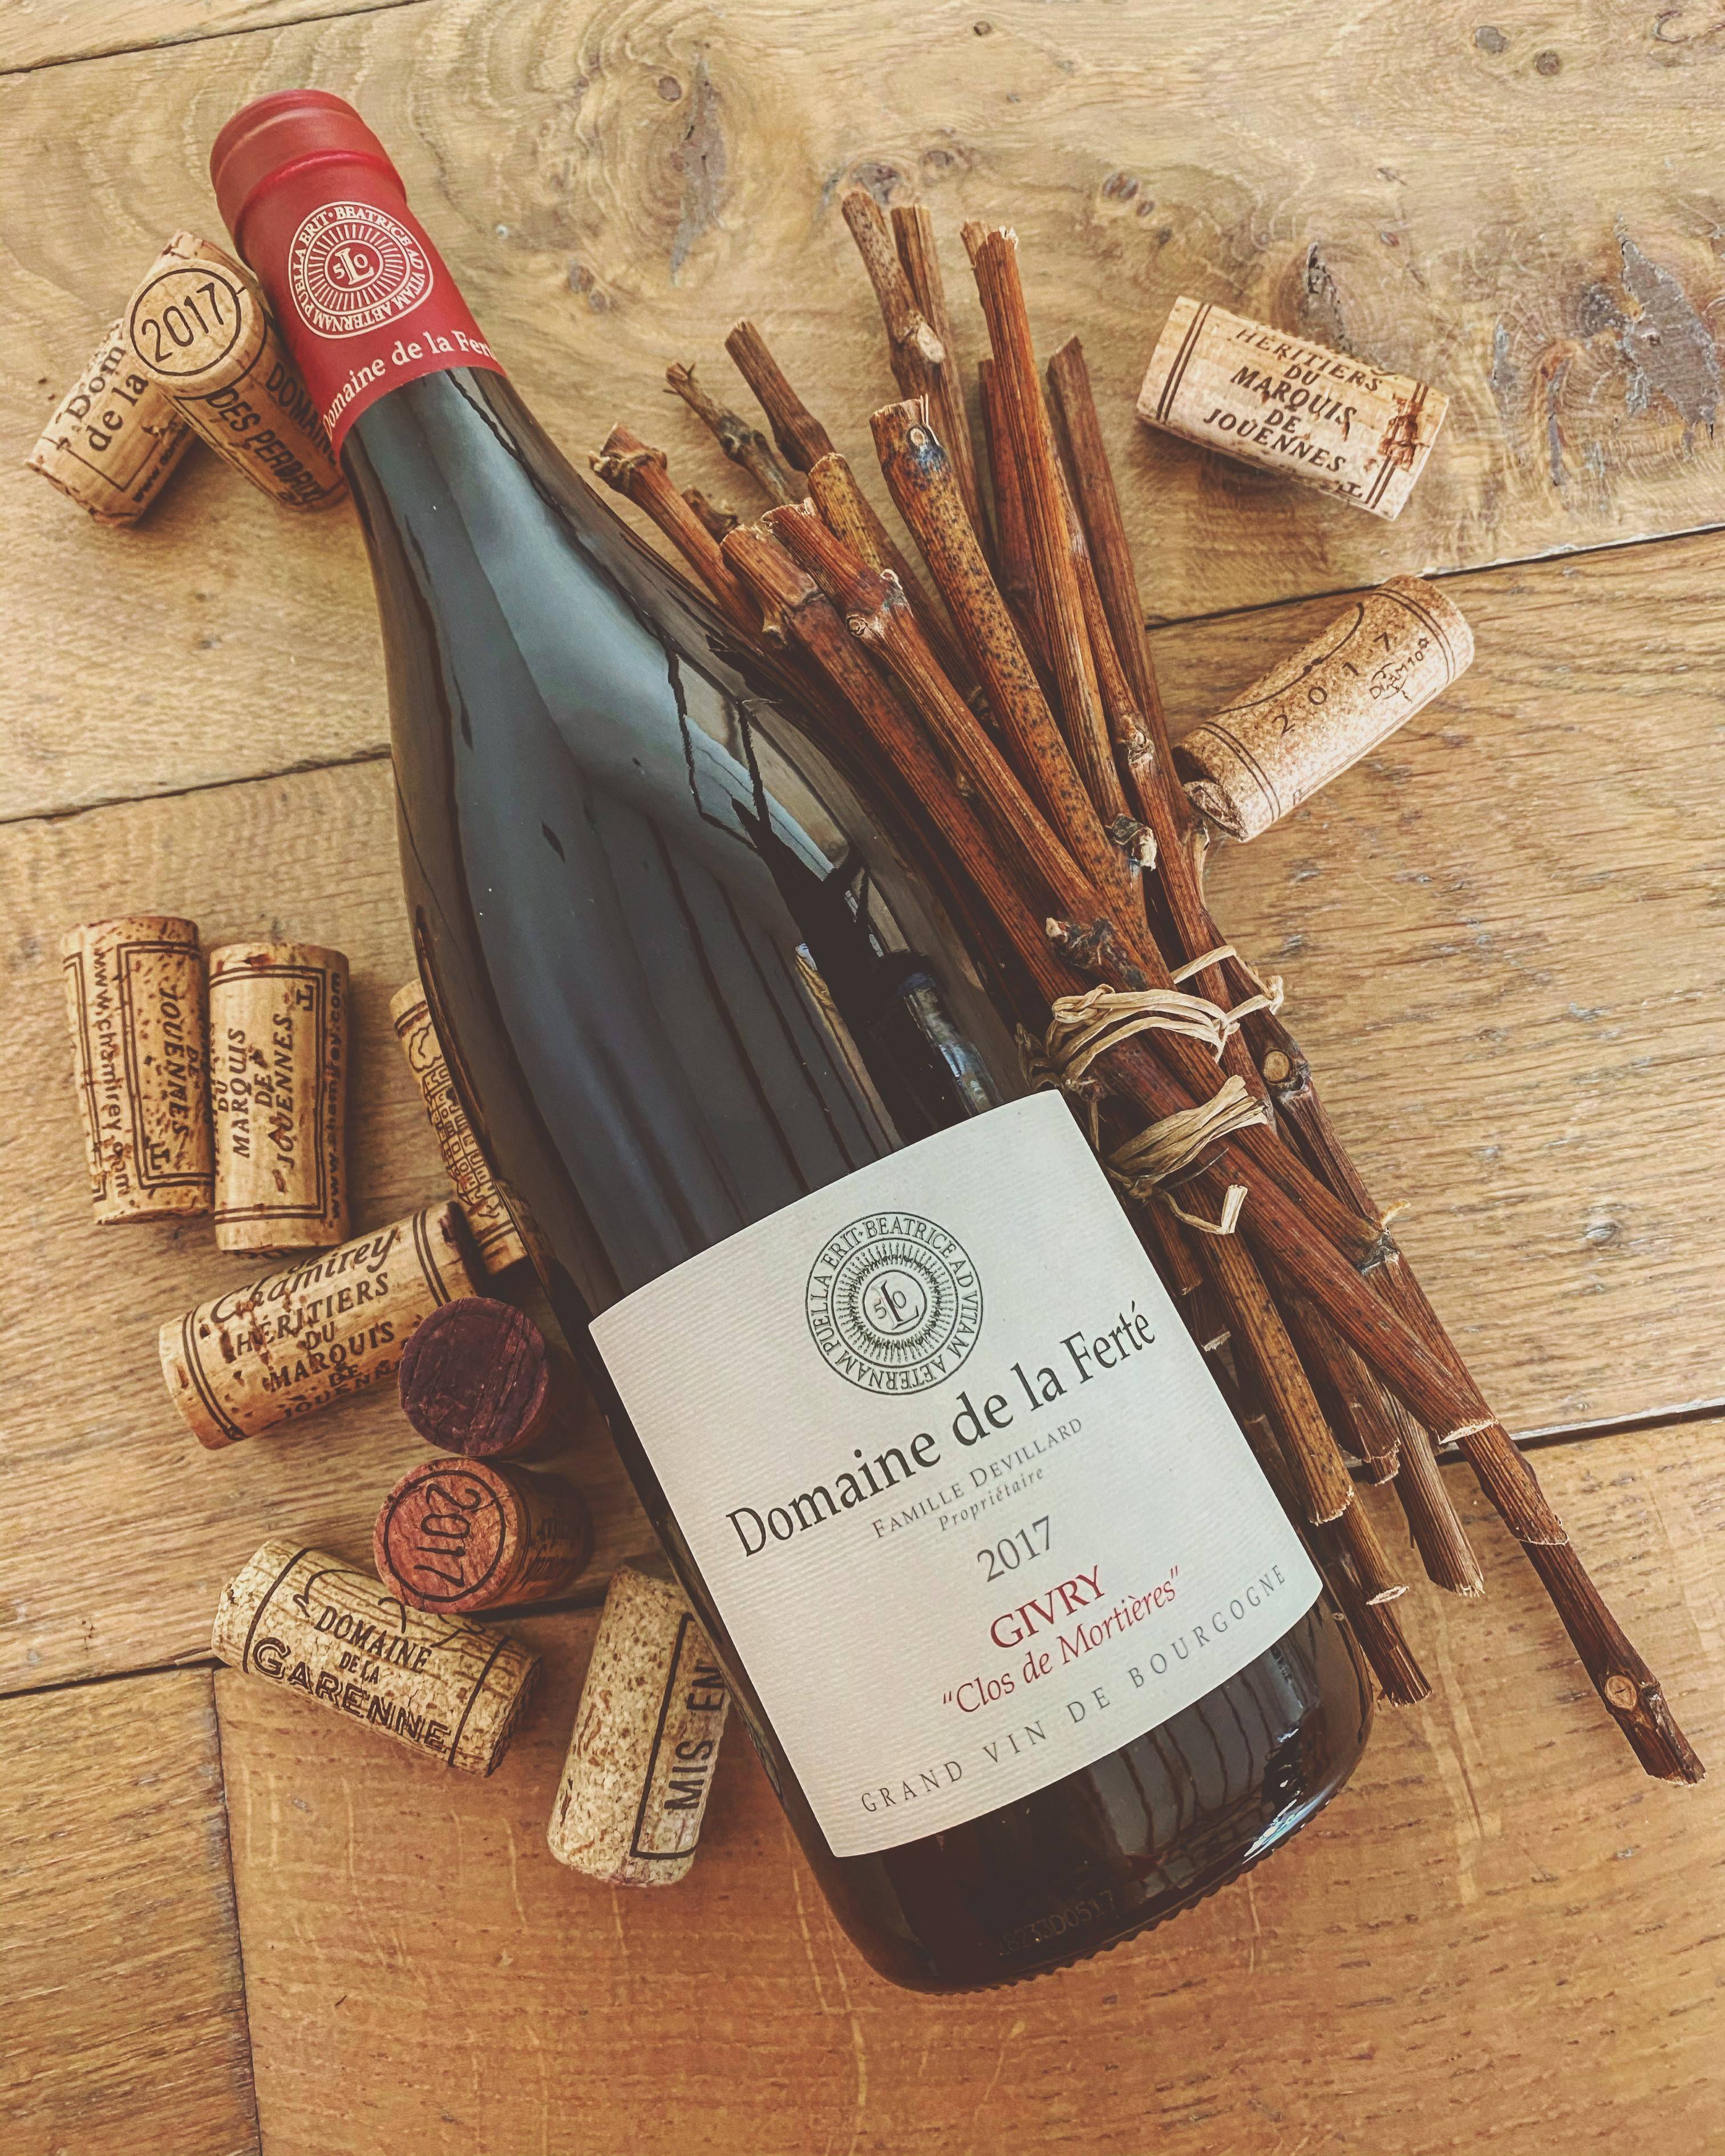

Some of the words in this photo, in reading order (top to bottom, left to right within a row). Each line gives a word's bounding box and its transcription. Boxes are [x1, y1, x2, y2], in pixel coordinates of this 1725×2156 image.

[298, 212, 330, 246] ERIT
[334, 206, 412, 246] BEATRICE
[405, 246, 424, 270] AD
[293, 248, 315, 318] PUELLA
[391, 272, 426, 310] VITAM
[142, 282, 225, 363] 2017
[323, 359, 386, 443] Domaine
[391, 341, 424, 365] de
[423, 331, 455, 354] la
[1229, 366, 1358, 425] MARQUIS
[1283, 364, 1321, 387] DU
[86, 410, 124, 451] de
[111, 374, 149, 407] la
[204, 387, 261, 432] DES
[1203, 408, 1347, 473] JOUENNES
[1264, 408, 1302, 435] DE
[1272, 631, 1395, 735] 2017
[158, 983, 190, 1137] JOUENNES
[228, 1027, 252, 1159] MARQUIS
[254, 1073, 275, 1108] DE
[273, 1014, 295, 1169] JOUENNES
[217, 1081, 229, 1112] DU
[820, 1228, 861, 1270] ERIT
[862, 1216, 957, 1259] BEATRICE
[210, 1226, 399, 1324] Chamirey
[949, 1258, 974, 1288] AD
[305, 1320, 335, 1351] DU
[811, 1274, 841, 1356] PUELLA
[947, 1290, 978, 1359] VITAM
[269, 1320, 395, 1393] MARQUIS
[835, 1349, 947, 1391] AETERNAM
[726, 1432, 942, 1558] Domaine
[952, 1391, 1014, 1447] de
[1011, 1362, 1068, 1412] la
[1060, 1300, 1156, 1385] Ferté
[871, 1481, 965, 1538] FAMILLE
[968, 1417, 1082, 1490] DEVILLARD
[937, 1467, 1044, 1532] Propriétaire
[413, 1483, 483, 1588] 2017
[977, 1515, 1052, 1582] 2017
[313, 1604, 432, 1674] DOMAINE
[990, 1565, 1106, 1649] GIVRY
[252, 1636, 452, 1754] GARENNE
[339, 1651, 361, 1674] DE
[361, 1660, 380, 1685] LA
[686, 1657, 725, 1711] EN
[861, 1760, 964, 1813] GRAND
[982, 1720, 1047, 1764] VIN
[1066, 1687, 1111, 1724] DE
[1127, 1565, 1286, 1689] BOURGOGNE
[1022, 1649, 1053, 1685] de
[663, 1739, 714, 1811] MIS
